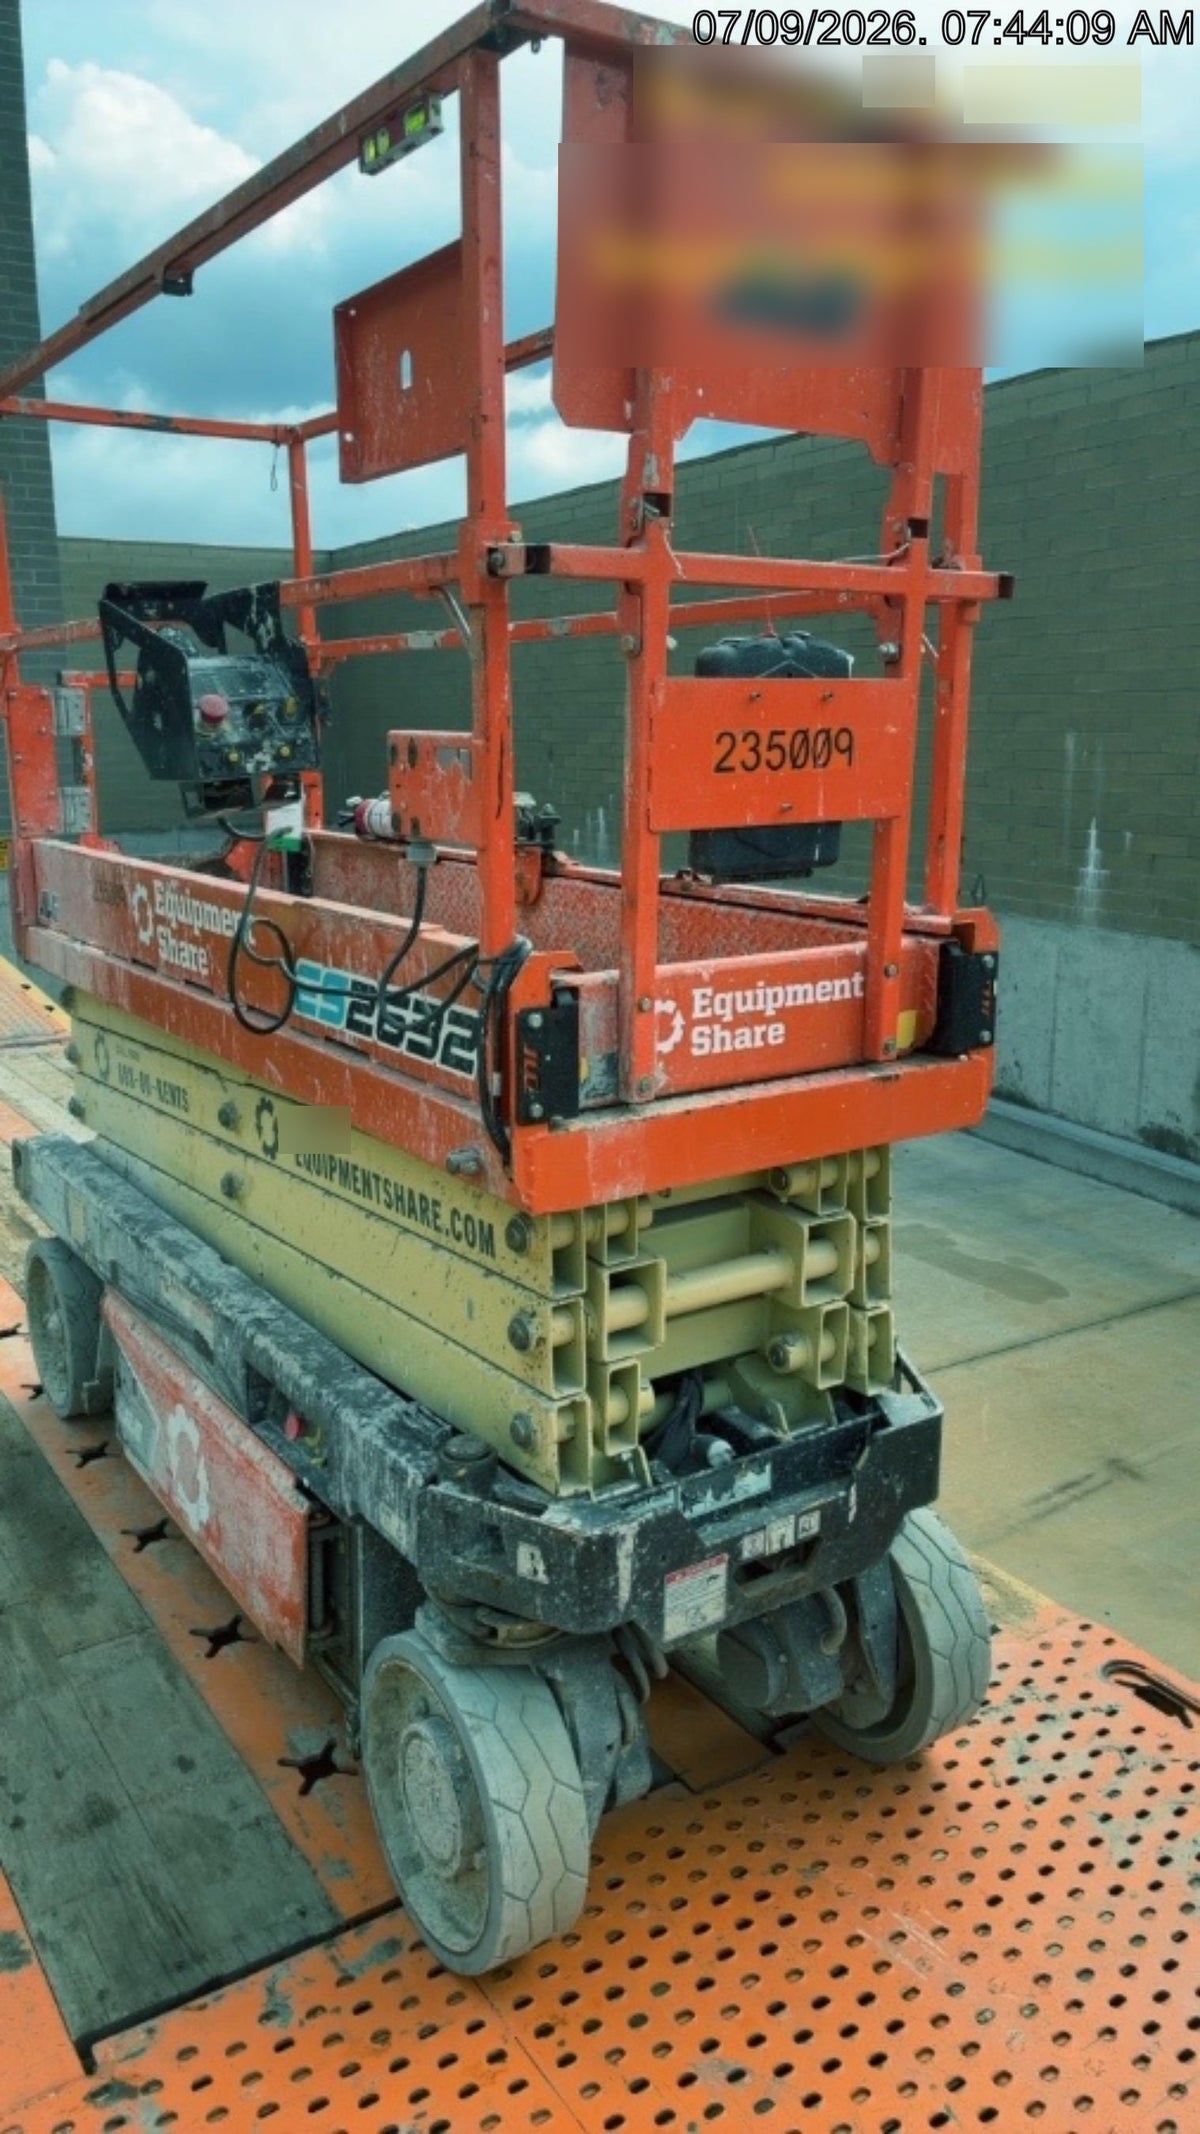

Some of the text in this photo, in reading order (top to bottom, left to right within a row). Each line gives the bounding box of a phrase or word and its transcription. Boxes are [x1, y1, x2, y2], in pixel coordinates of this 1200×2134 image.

[713, 727, 854, 773] 235009
[154, 879, 257, 946] Equipme
[156, 924, 210, 976] Share
[692, 971, 865, 1022] Equipment
[691, 1022, 786, 1056] Share
